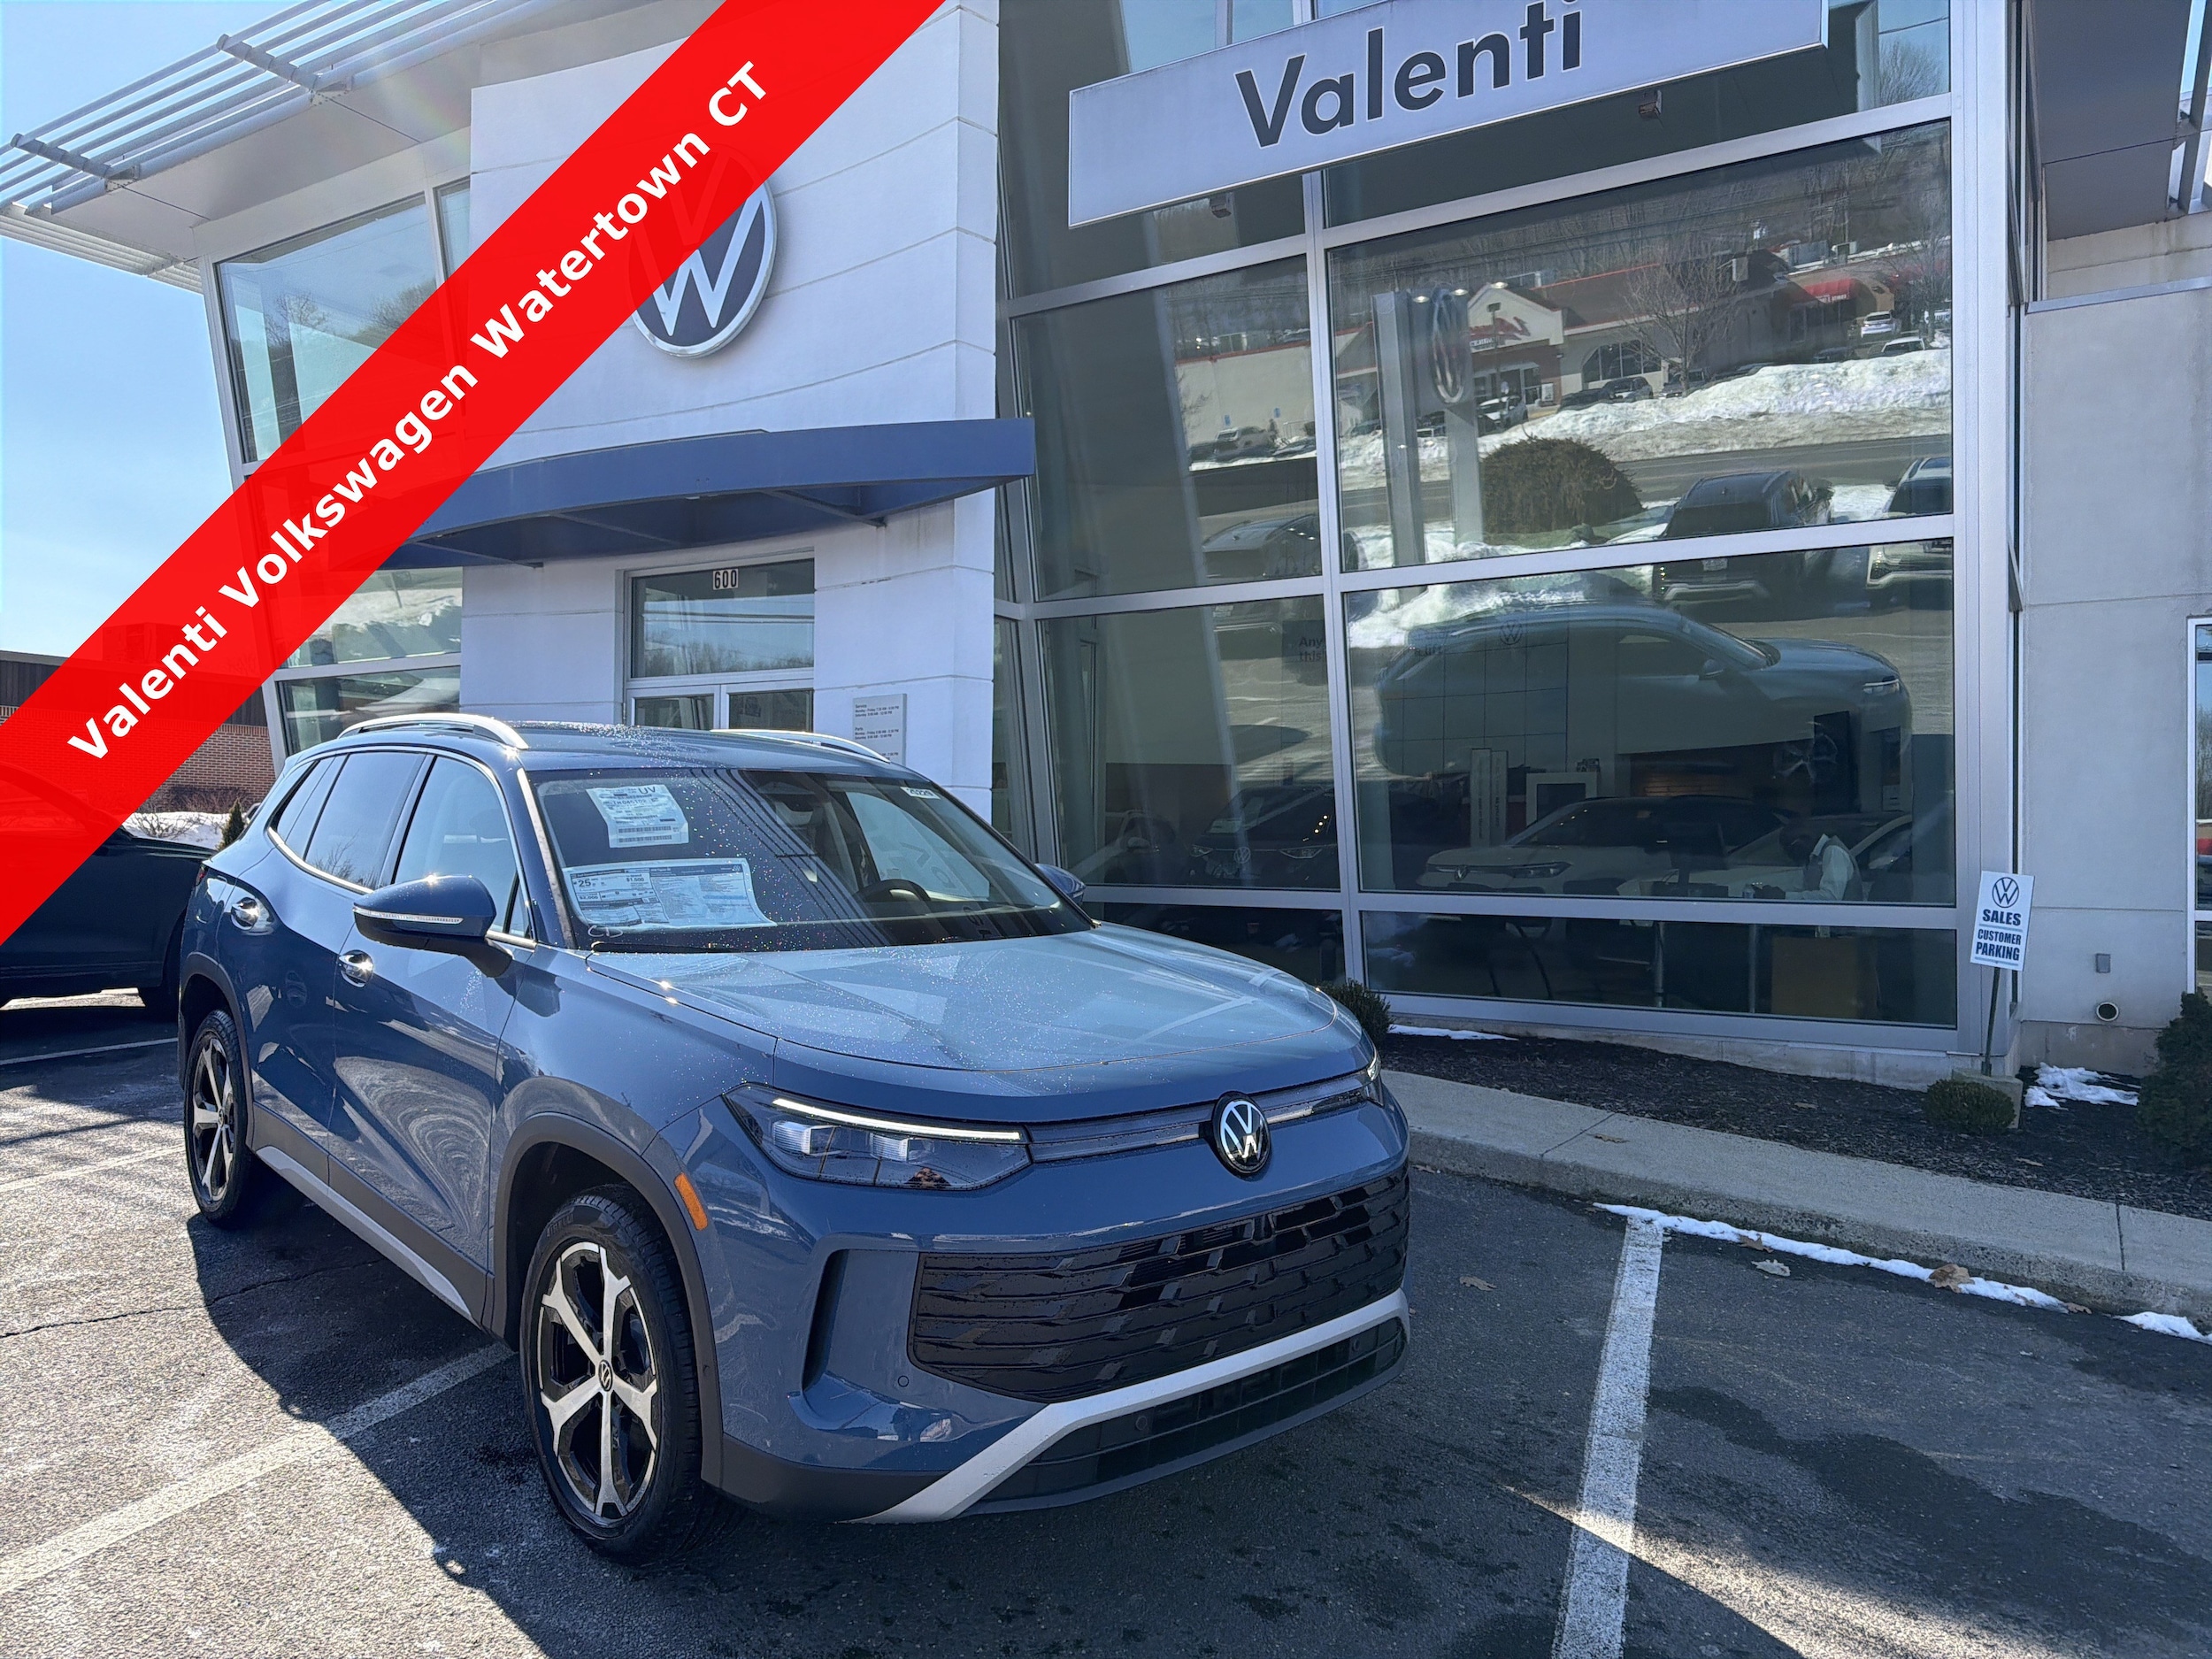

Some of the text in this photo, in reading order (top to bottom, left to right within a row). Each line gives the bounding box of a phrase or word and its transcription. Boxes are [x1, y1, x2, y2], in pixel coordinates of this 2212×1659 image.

[1234, 0, 1583, 149] Valenti
[714, 570, 737, 589] 600
[638, 786, 657, 795] UV
[578, 879, 592, 888] 25
[1992, 876, 2020, 909] VW
[1982, 909, 2022, 926] SALES
[1978, 928, 2022, 946] CUSTOMER
[1975, 941, 2021, 962] PARKING
